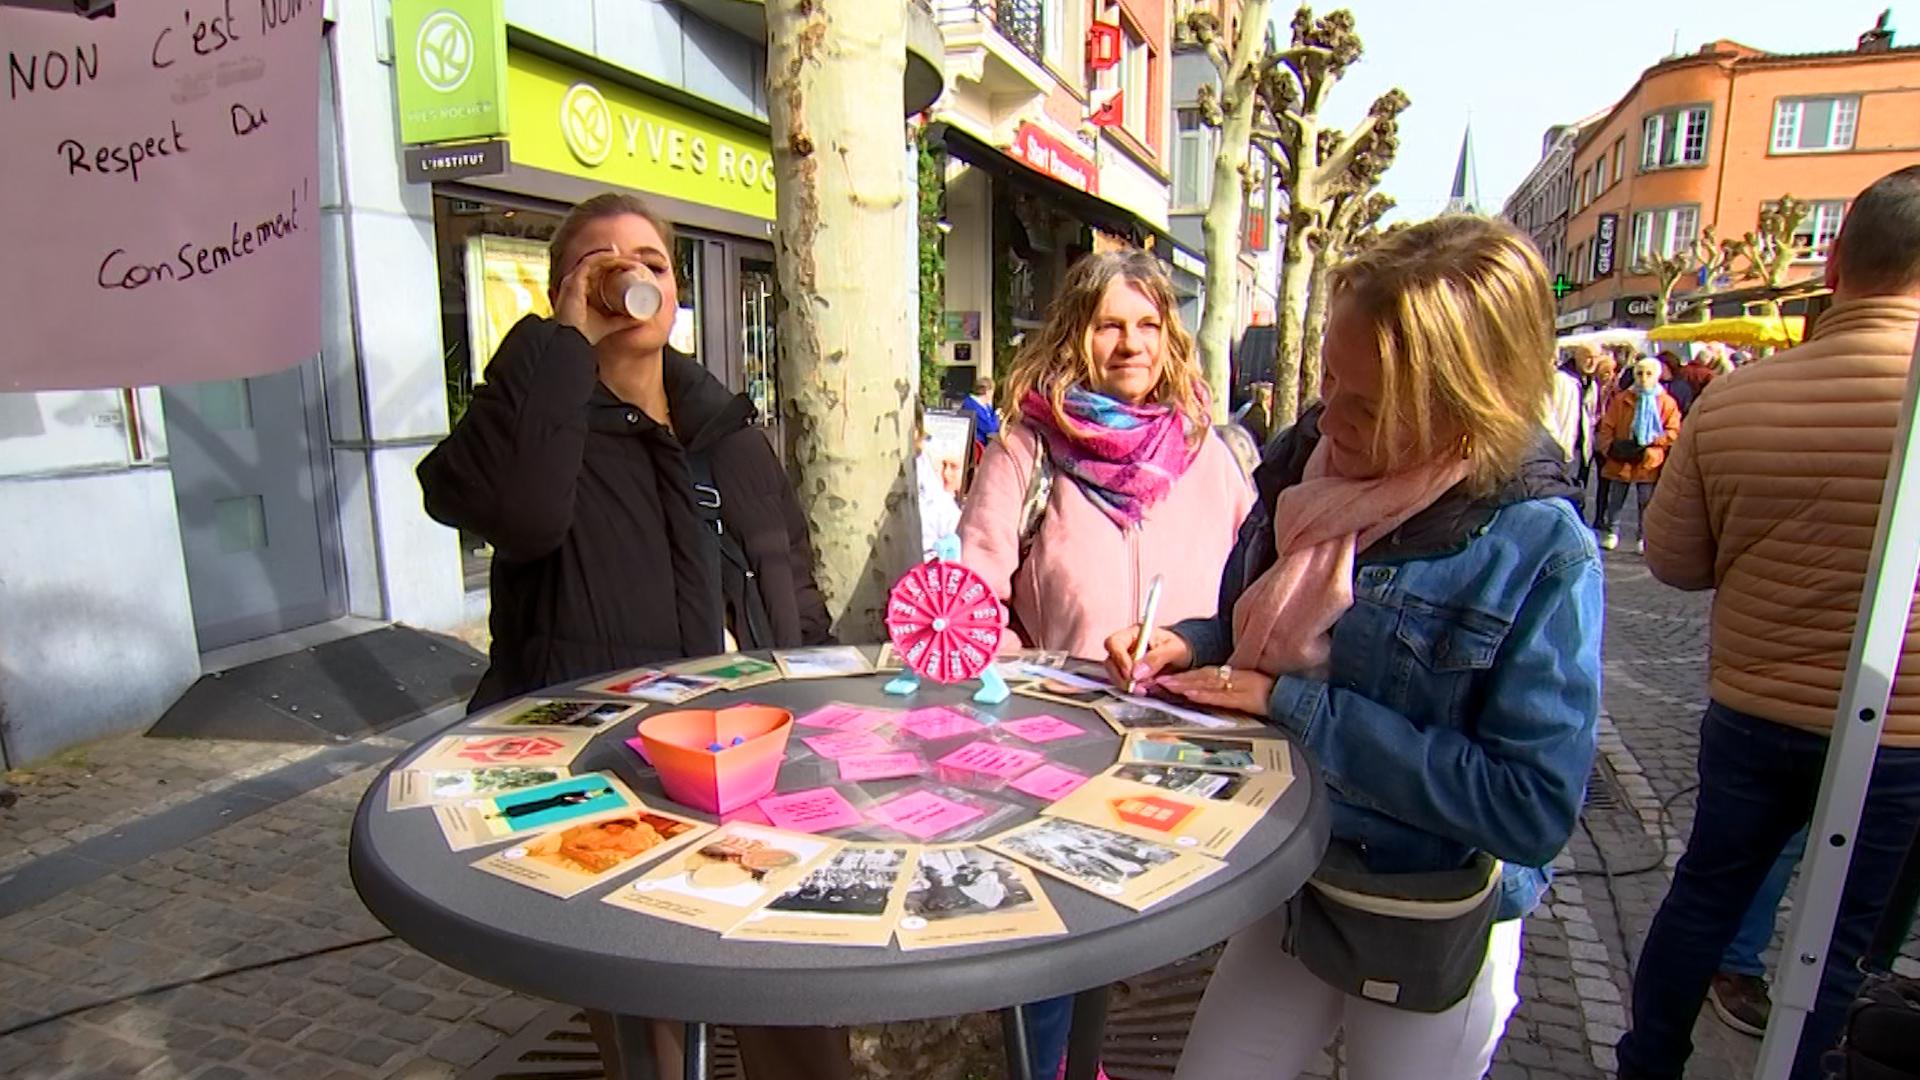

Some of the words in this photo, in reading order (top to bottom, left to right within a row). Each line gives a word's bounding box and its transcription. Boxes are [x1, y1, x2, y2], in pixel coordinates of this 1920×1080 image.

[9, 43, 98, 100] NON
[58, 120, 190, 181] Respect
[231, 103, 268, 135] Du
[421, 152, 485, 170] L'INSTITUT
[620, 113, 708, 173] YVES
[717, 144, 777, 191] ROC
[1598, 216, 1614, 274] GIELEN
[1628, 300, 1689, 315] GIEN
